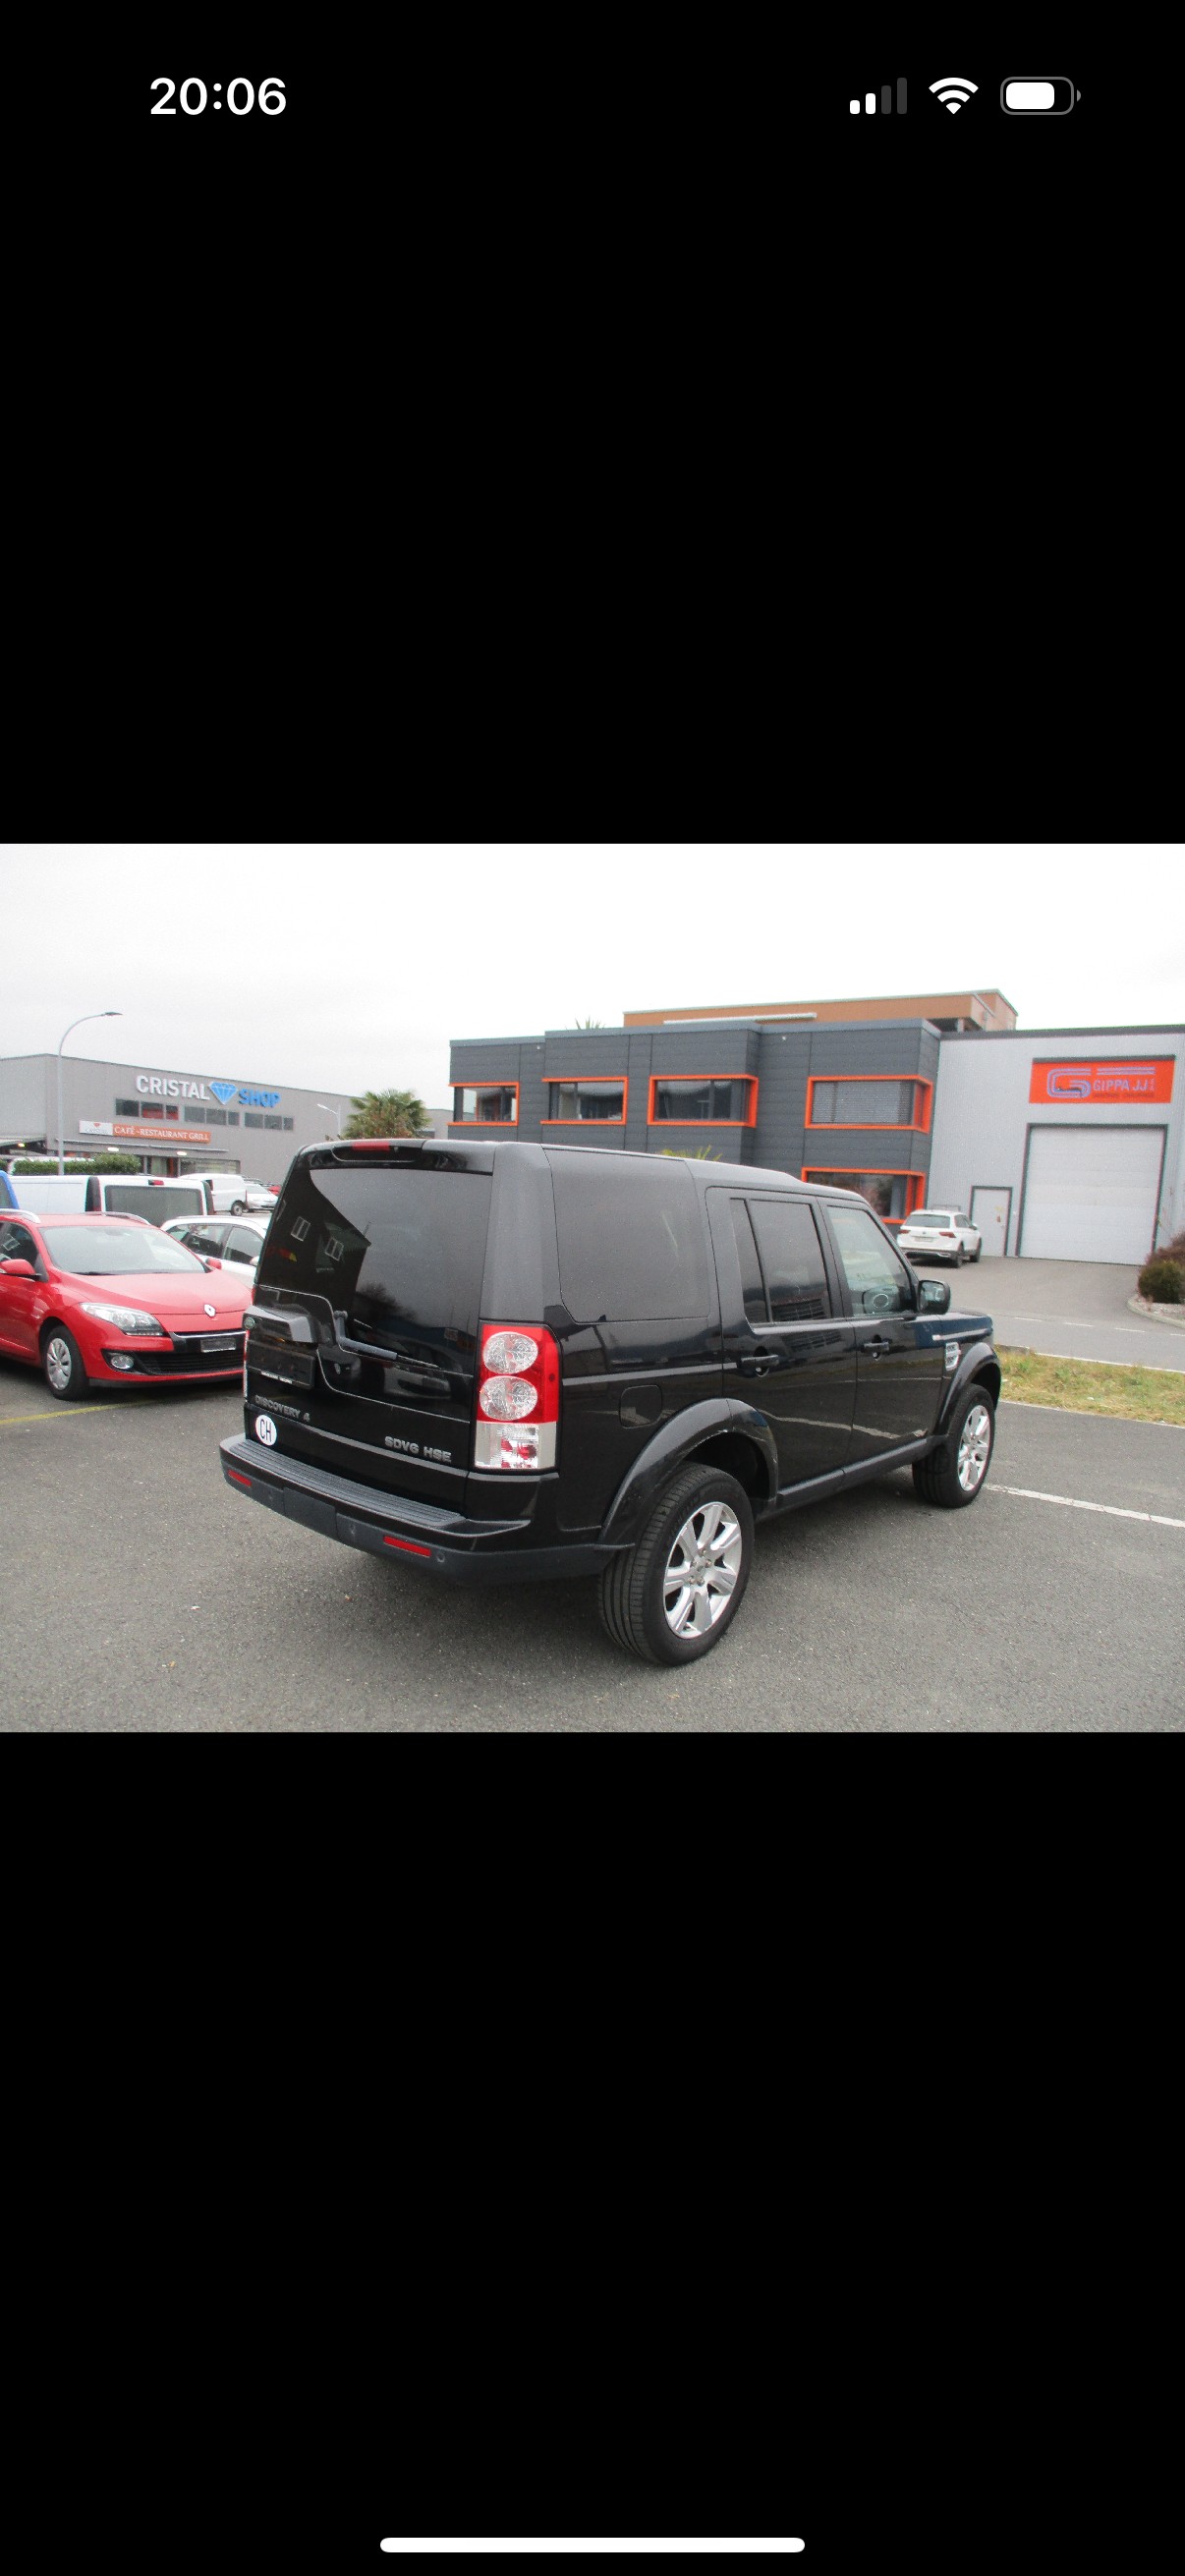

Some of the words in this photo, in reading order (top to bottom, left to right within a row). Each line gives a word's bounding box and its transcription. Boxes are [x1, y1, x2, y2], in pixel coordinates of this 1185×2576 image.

[136, 1075, 210, 1100] CRISTAL
[239, 1088, 281, 1107] SHOP
[1094, 1079, 1129, 1092] GIPPA
[114, 1125, 135, 1135] CAFÉ
[188, 1132, 209, 1141] GRILL
[255, 1394, 301, 1419] DISCOVERY
[303, 1412, 310, 1423] 4
[259, 1419, 272, 1442] CH
[384, 1435, 420, 1454] SDV6
[423, 1446, 452, 1463] HSE
